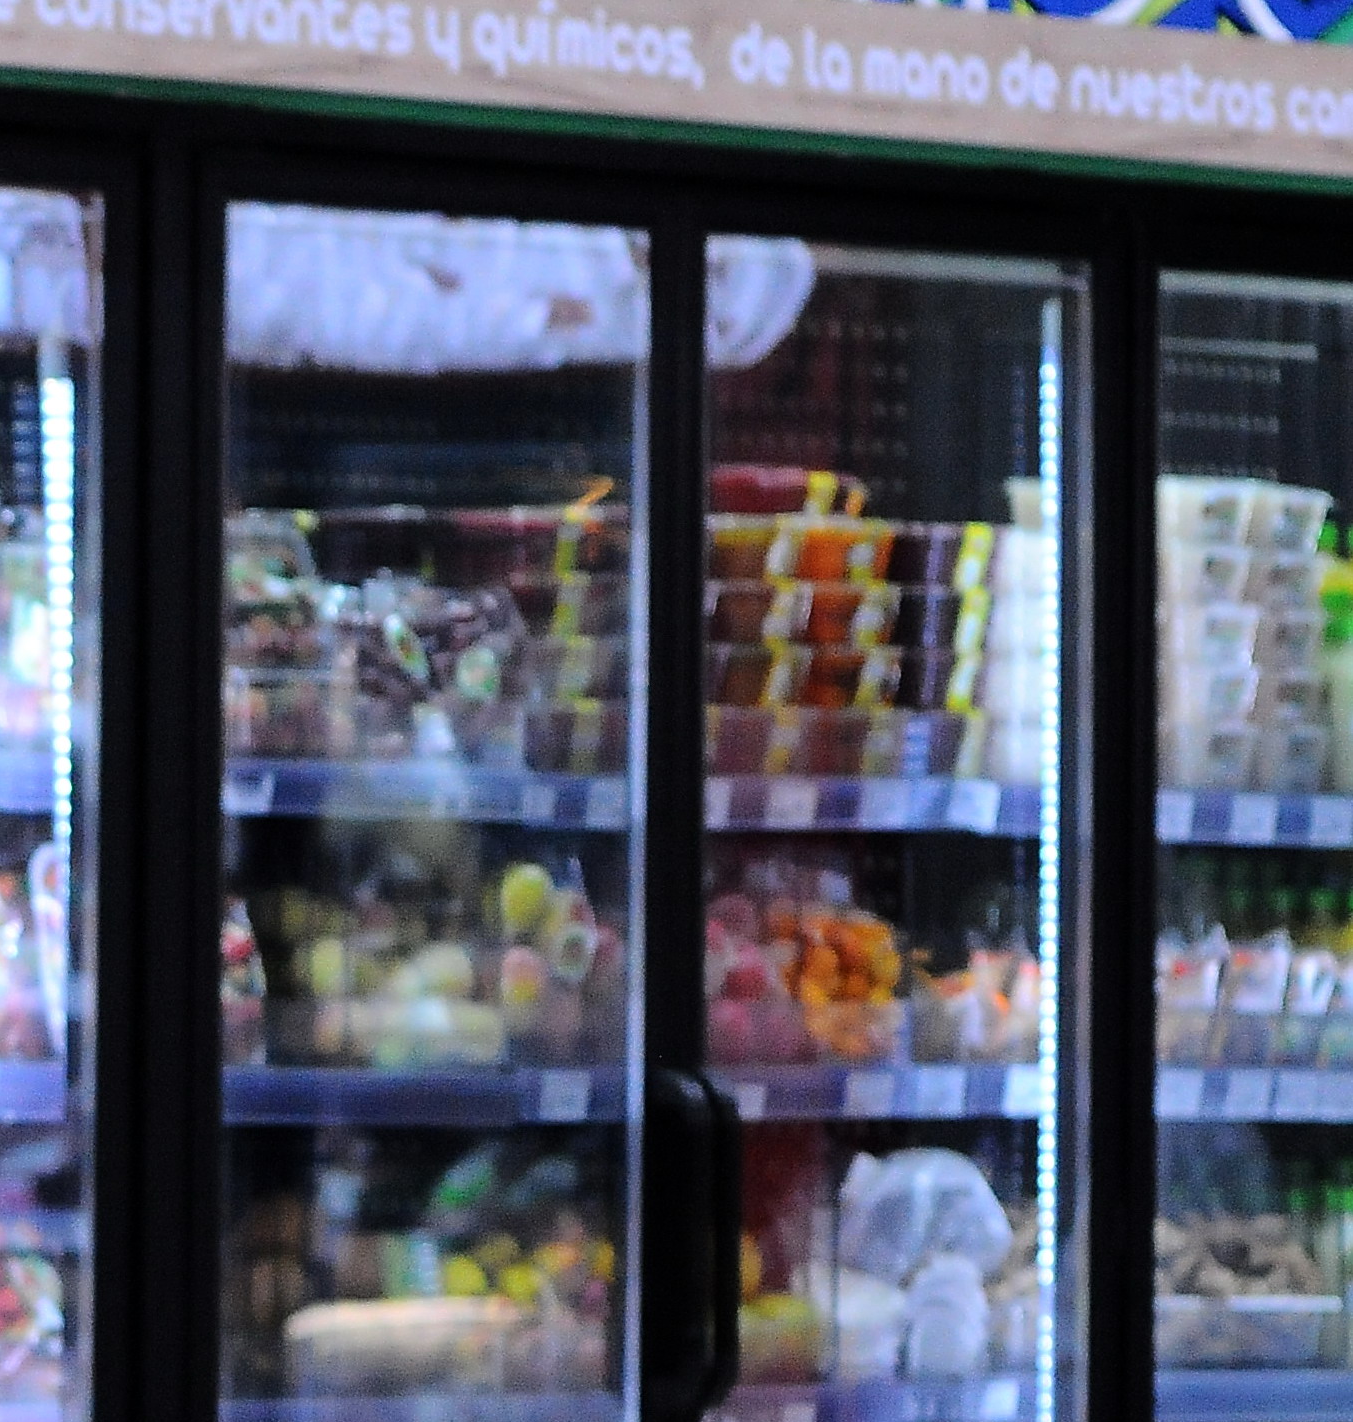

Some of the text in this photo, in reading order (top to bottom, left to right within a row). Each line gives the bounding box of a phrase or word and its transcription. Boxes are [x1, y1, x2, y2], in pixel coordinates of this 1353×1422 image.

[425, 6, 461, 75] y
[729, 21, 793, 87] de
[802, 26, 853, 94] la
[862, 45, 990, 105] mano
[1000, 47, 1058, 112] de
[1069, 62, 1277, 133] nuestros
